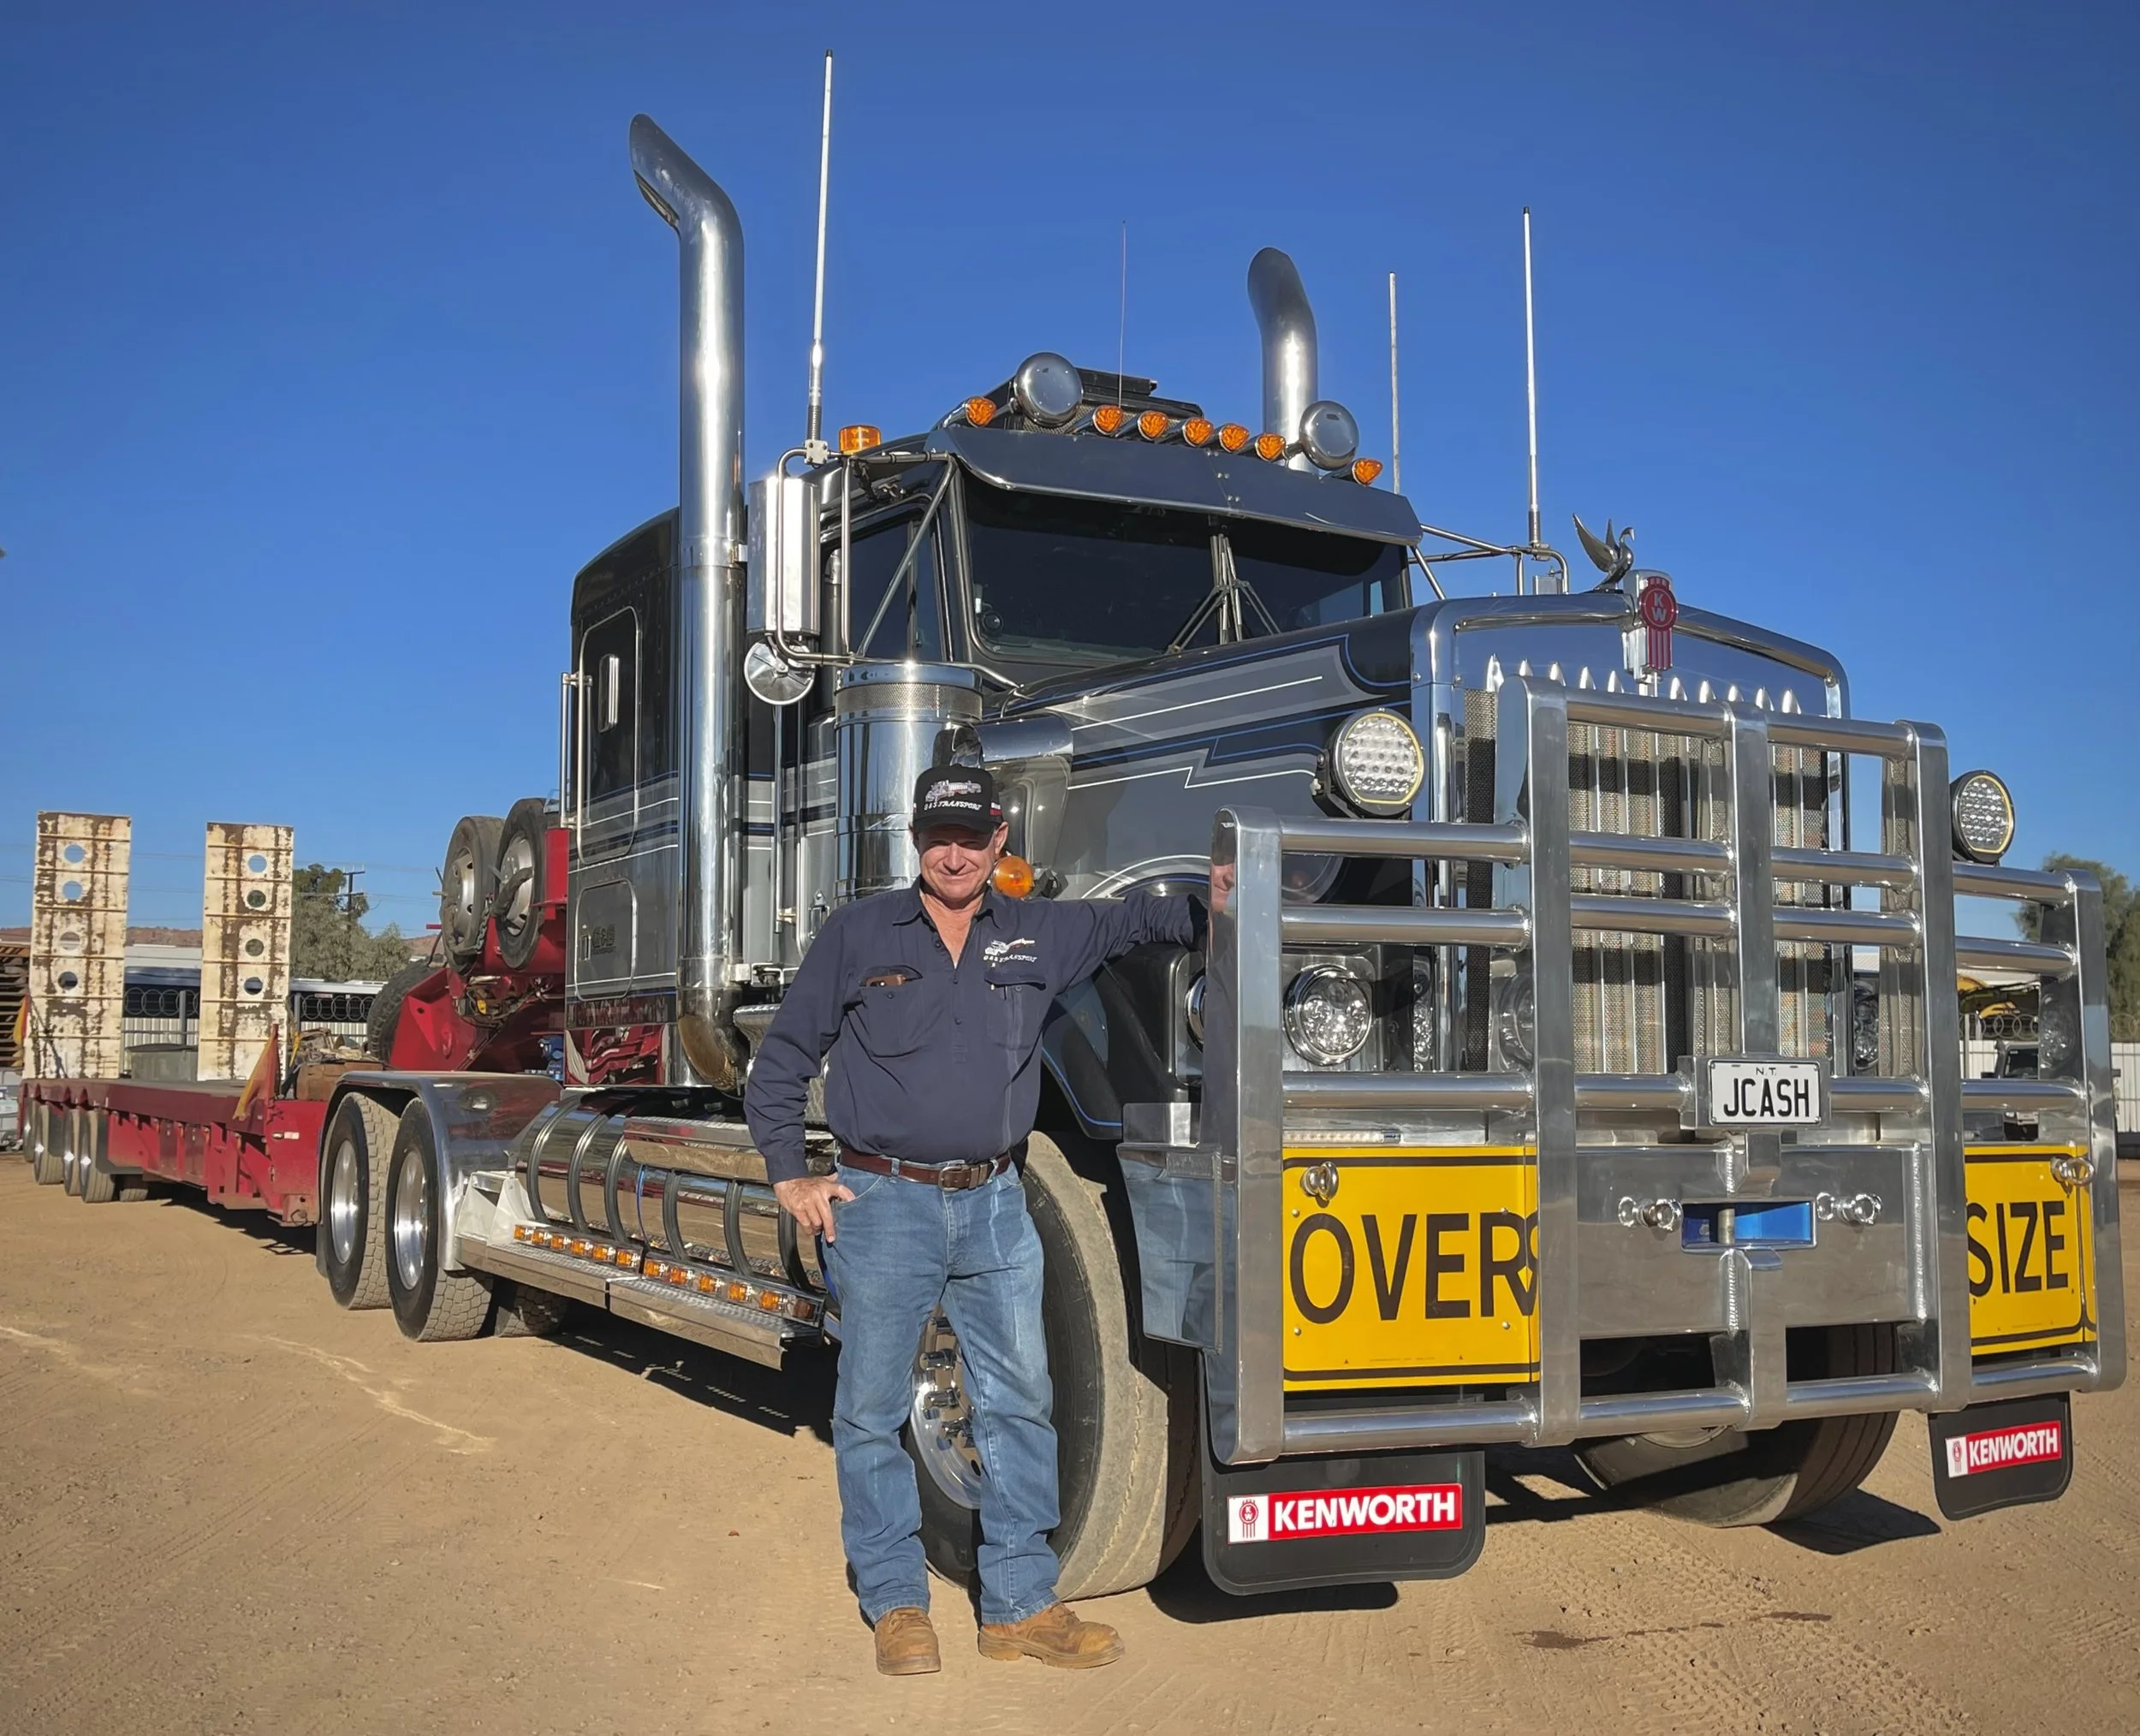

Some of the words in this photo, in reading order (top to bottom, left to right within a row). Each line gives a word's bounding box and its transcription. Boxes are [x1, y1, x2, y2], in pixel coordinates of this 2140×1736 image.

[1723, 1078, 1810, 1117] JCASH
[1966, 1200, 2069, 1298] SIZE
[1969, 1428, 2058, 1467] KENWORTH
[1275, 1492, 1455, 1532] KENWORTH
